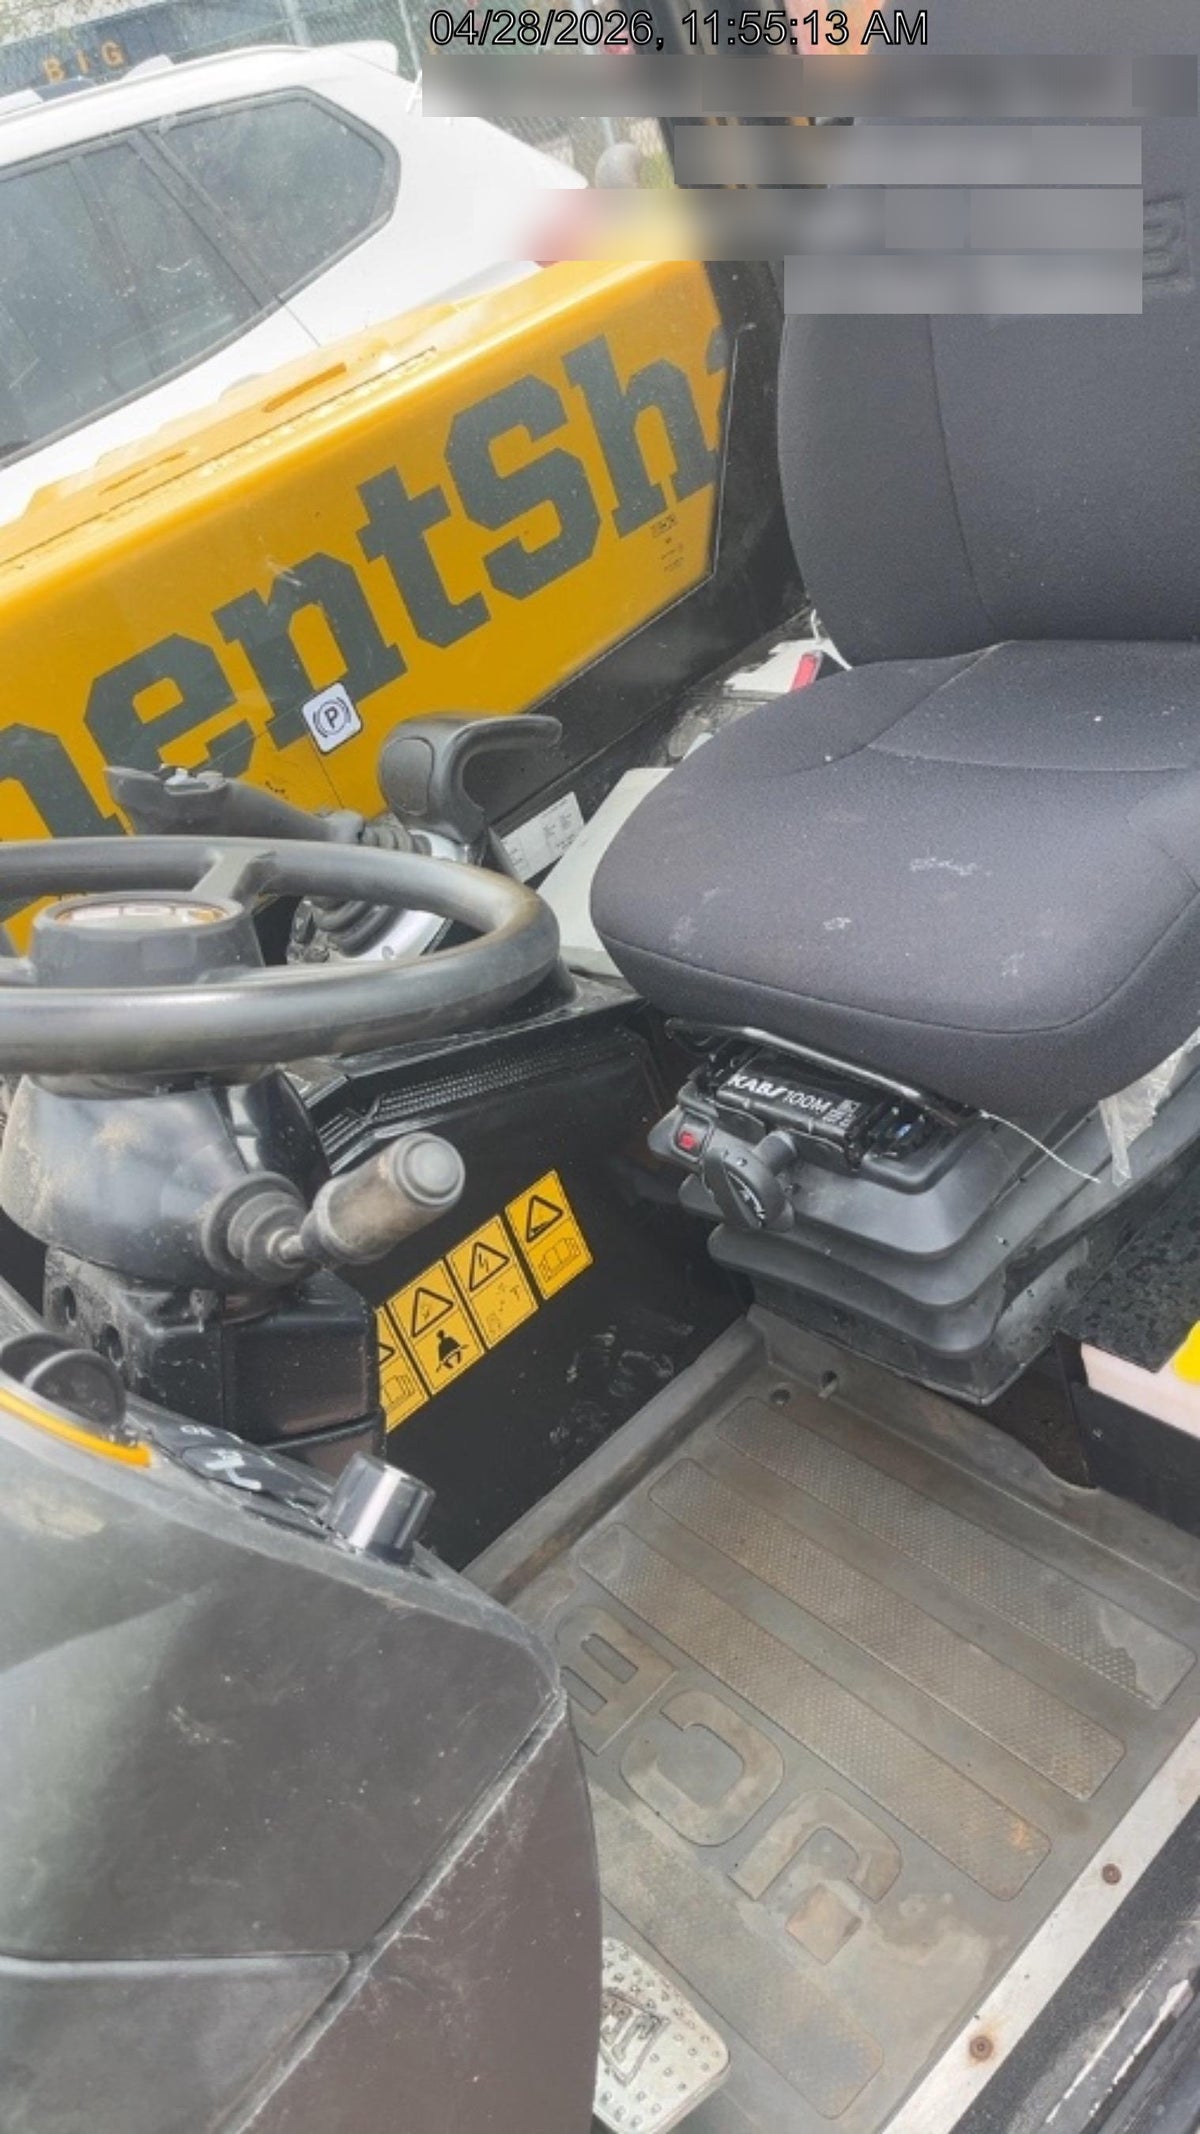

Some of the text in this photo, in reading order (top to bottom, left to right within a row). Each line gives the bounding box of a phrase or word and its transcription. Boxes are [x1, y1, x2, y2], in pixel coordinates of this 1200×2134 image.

[42, 39, 126, 83] BIG
[0, 328, 728, 860] entSh
[554, 1604, 902, 1965] JCB
